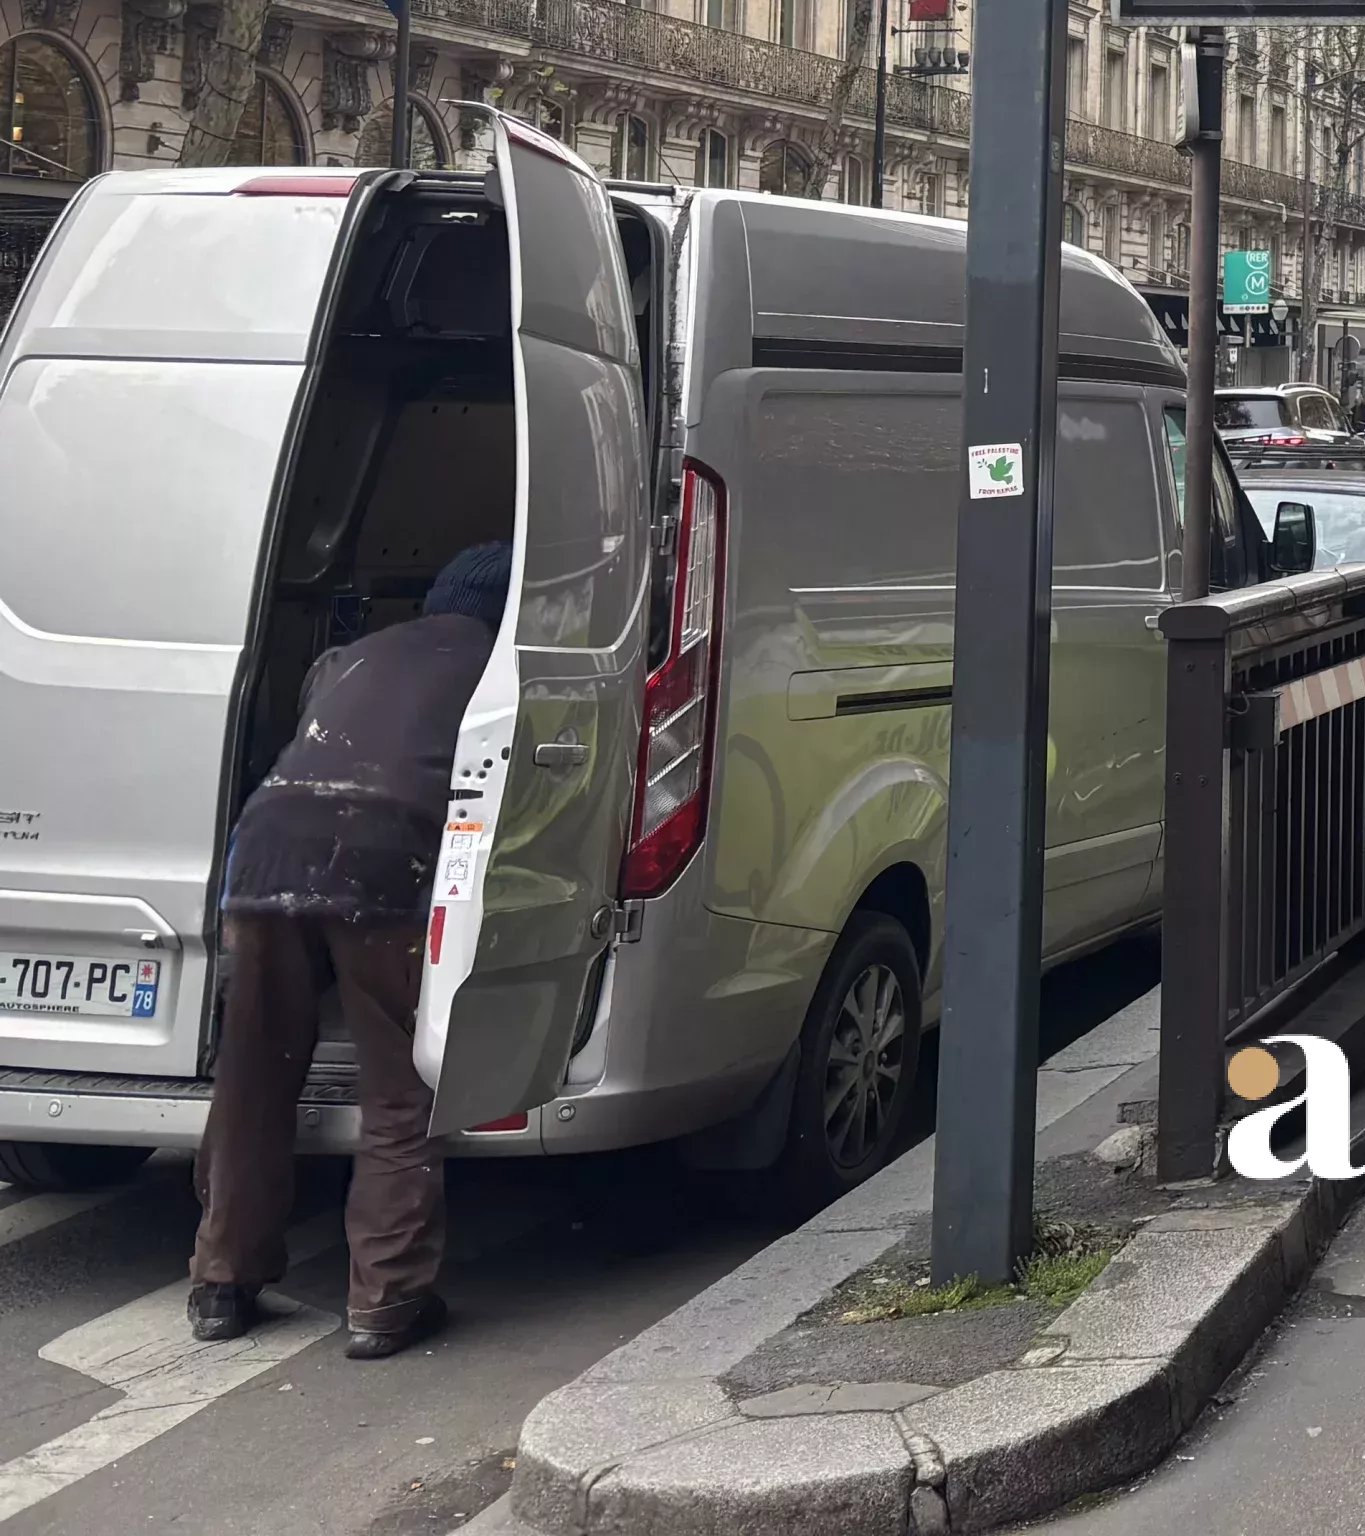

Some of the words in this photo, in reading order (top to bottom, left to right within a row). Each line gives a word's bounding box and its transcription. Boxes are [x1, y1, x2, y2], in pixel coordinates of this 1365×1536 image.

[1249, 253, 1268, 262] RER
[1251, 276, 1264, 289] M
[135, 990, 153, 1010] 78
